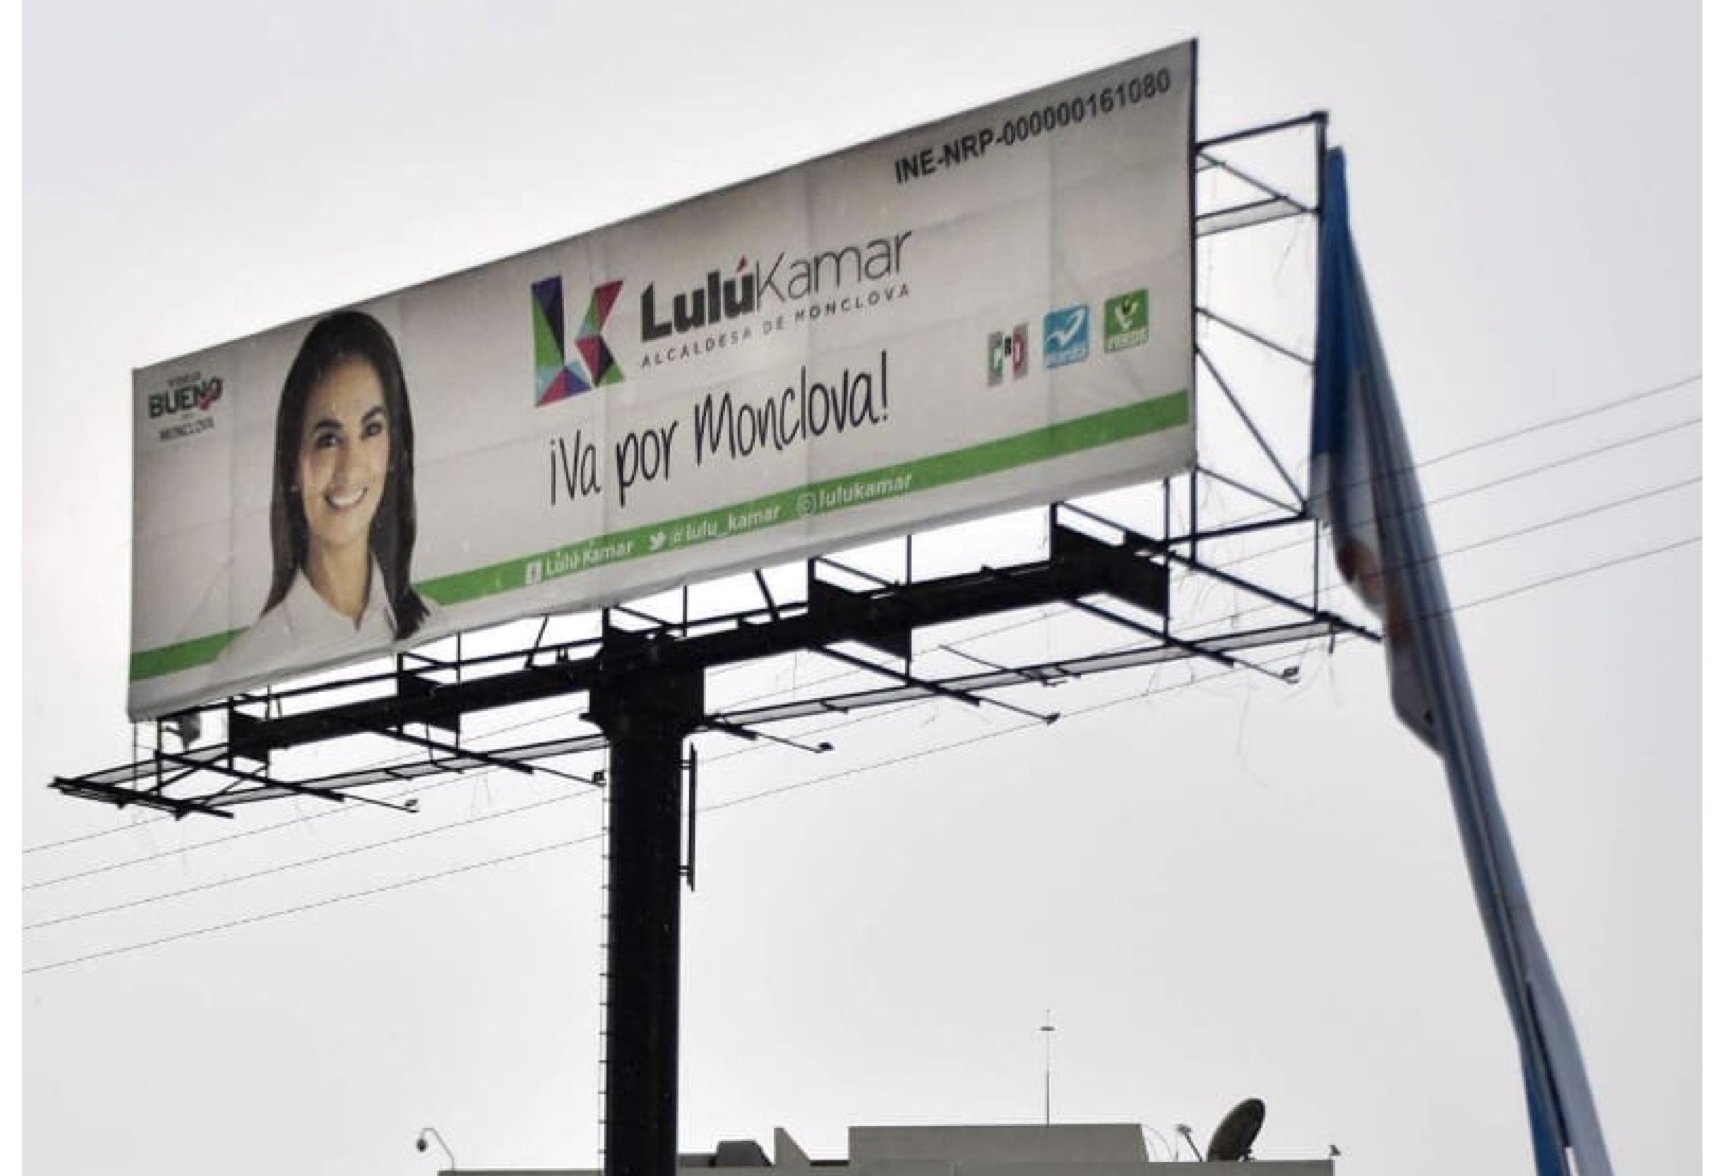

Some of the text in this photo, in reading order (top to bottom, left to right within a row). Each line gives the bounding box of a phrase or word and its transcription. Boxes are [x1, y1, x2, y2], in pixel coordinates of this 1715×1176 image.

[640, 283, 911, 368] ALCALDESA DE MONCLOVA
[148, 376, 224, 419] BUENO
[615, 420, 679, 508] por
[694, 349, 889, 466] Monclova!
